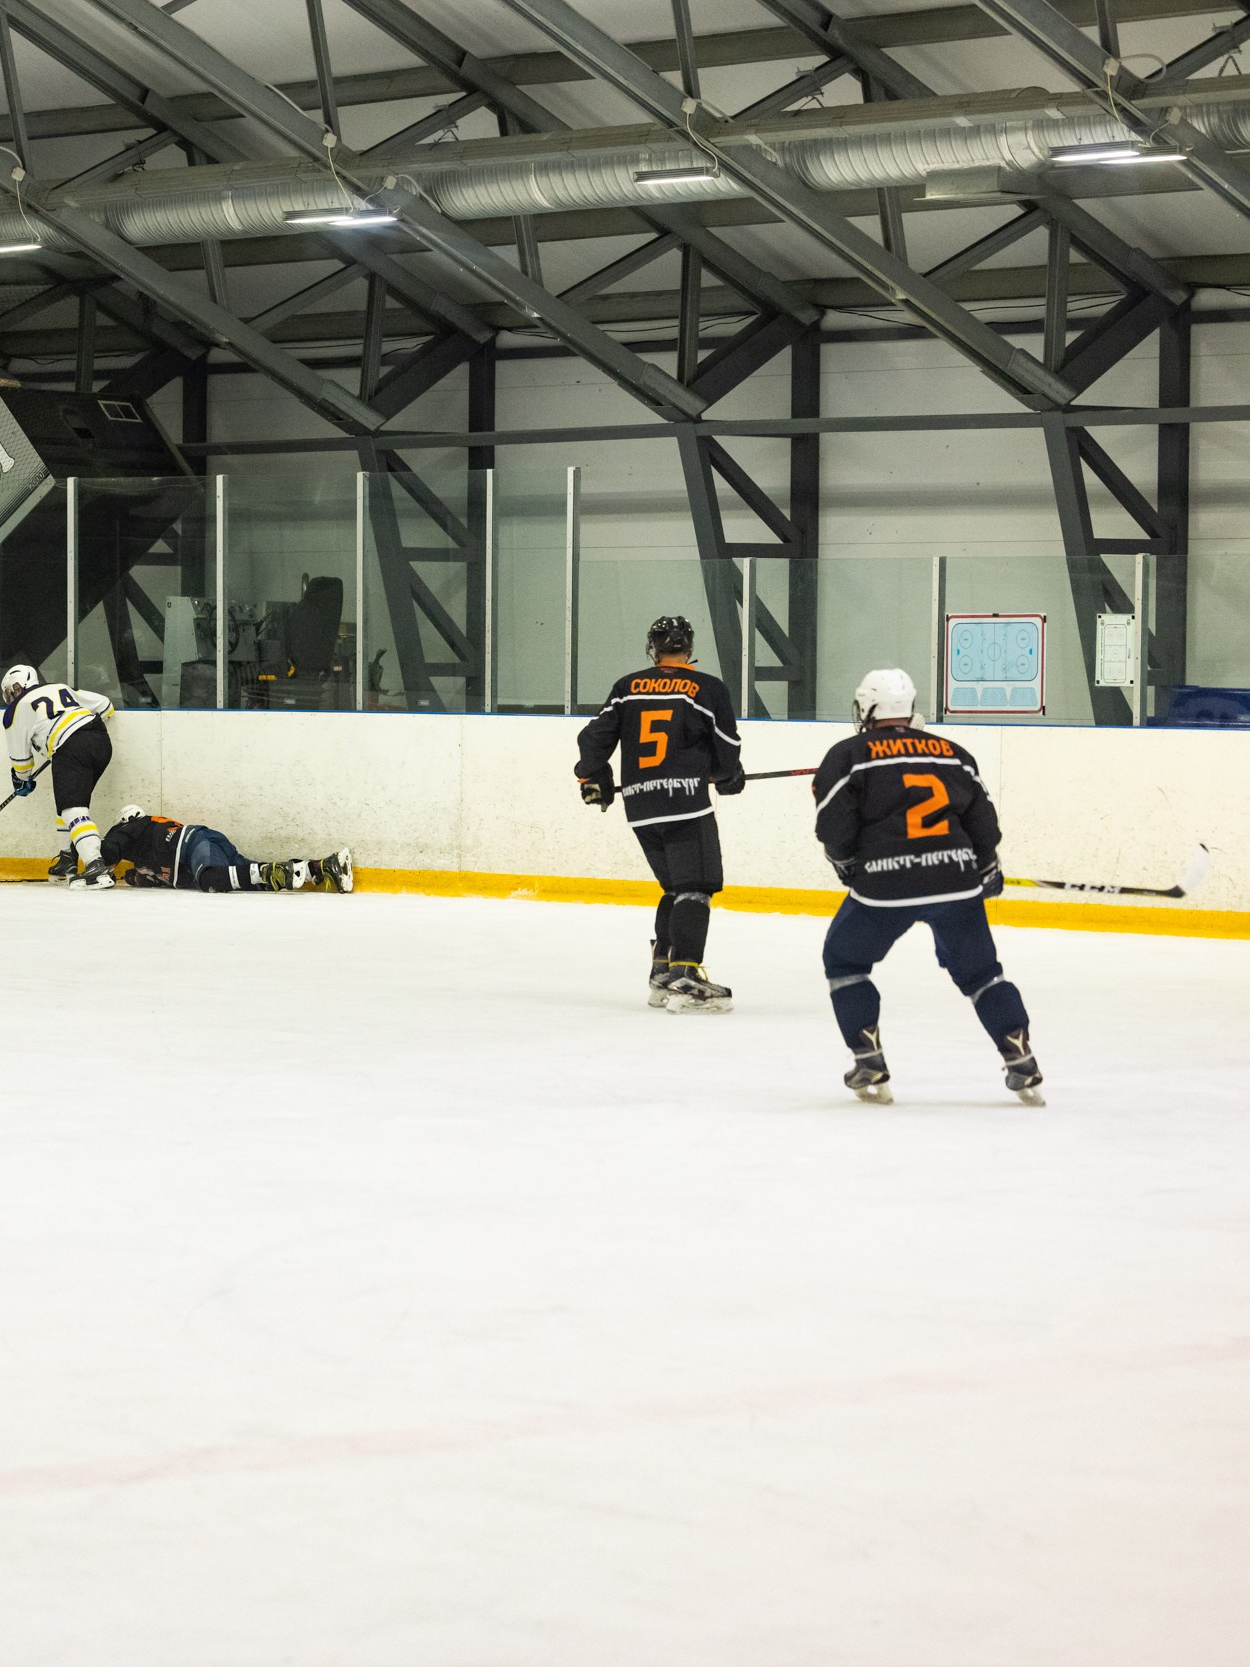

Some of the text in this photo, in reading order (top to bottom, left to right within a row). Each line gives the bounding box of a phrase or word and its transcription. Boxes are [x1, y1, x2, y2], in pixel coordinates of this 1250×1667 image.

[31, 688, 81, 720] 24
[630, 678, 700, 698] СОКОЛОВ
[638, 709, 674, 769] 5
[867, 738, 954, 759] ЖИТКОВ
[902, 773, 950, 839] 2
